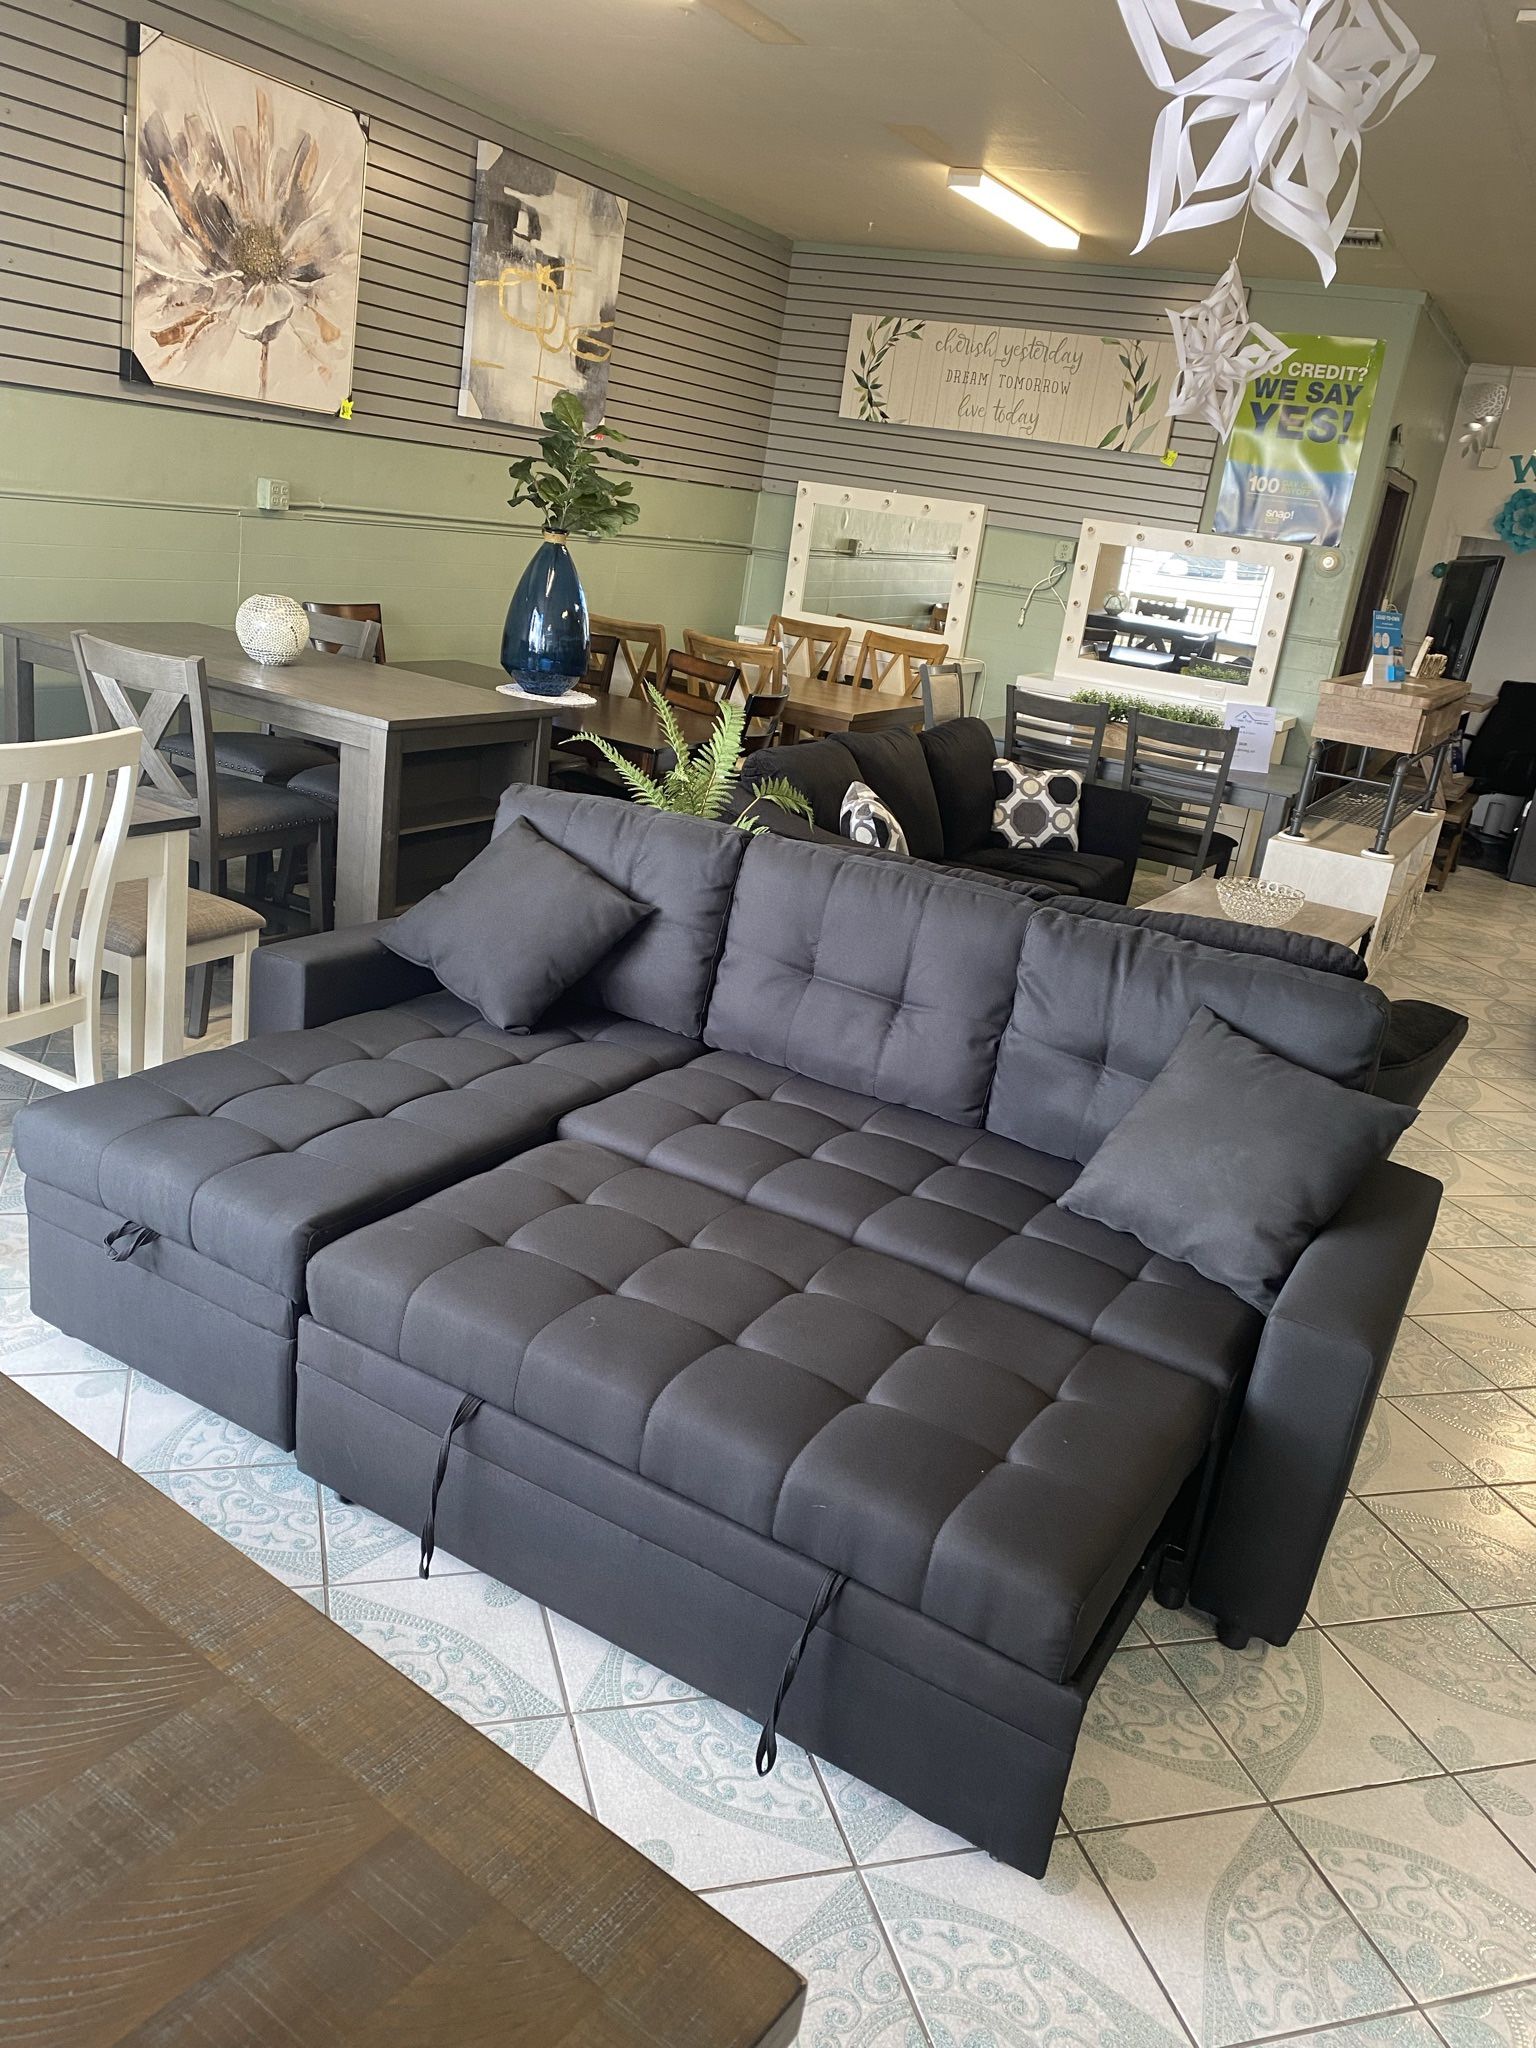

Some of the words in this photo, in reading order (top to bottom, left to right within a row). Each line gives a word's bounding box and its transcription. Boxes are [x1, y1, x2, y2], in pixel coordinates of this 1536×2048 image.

[935, 327, 998, 357] cherish
[994, 336, 1084, 375] yesterday
[945, 369, 989, 386] DREAM
[998, 373, 1071, 395] TOMORROW
[1288, 361, 1368, 382] CREDIT?
[1254, 377, 1298, 401] WE
[1305, 381, 1364, 406] SAY
[957, 393, 985, 418] live
[992, 398, 1040, 435] today
[1250, 401, 1354, 445] YES!
[1249, 475, 1280, 494] 100
[1265, 509, 1295, 521] snap!
